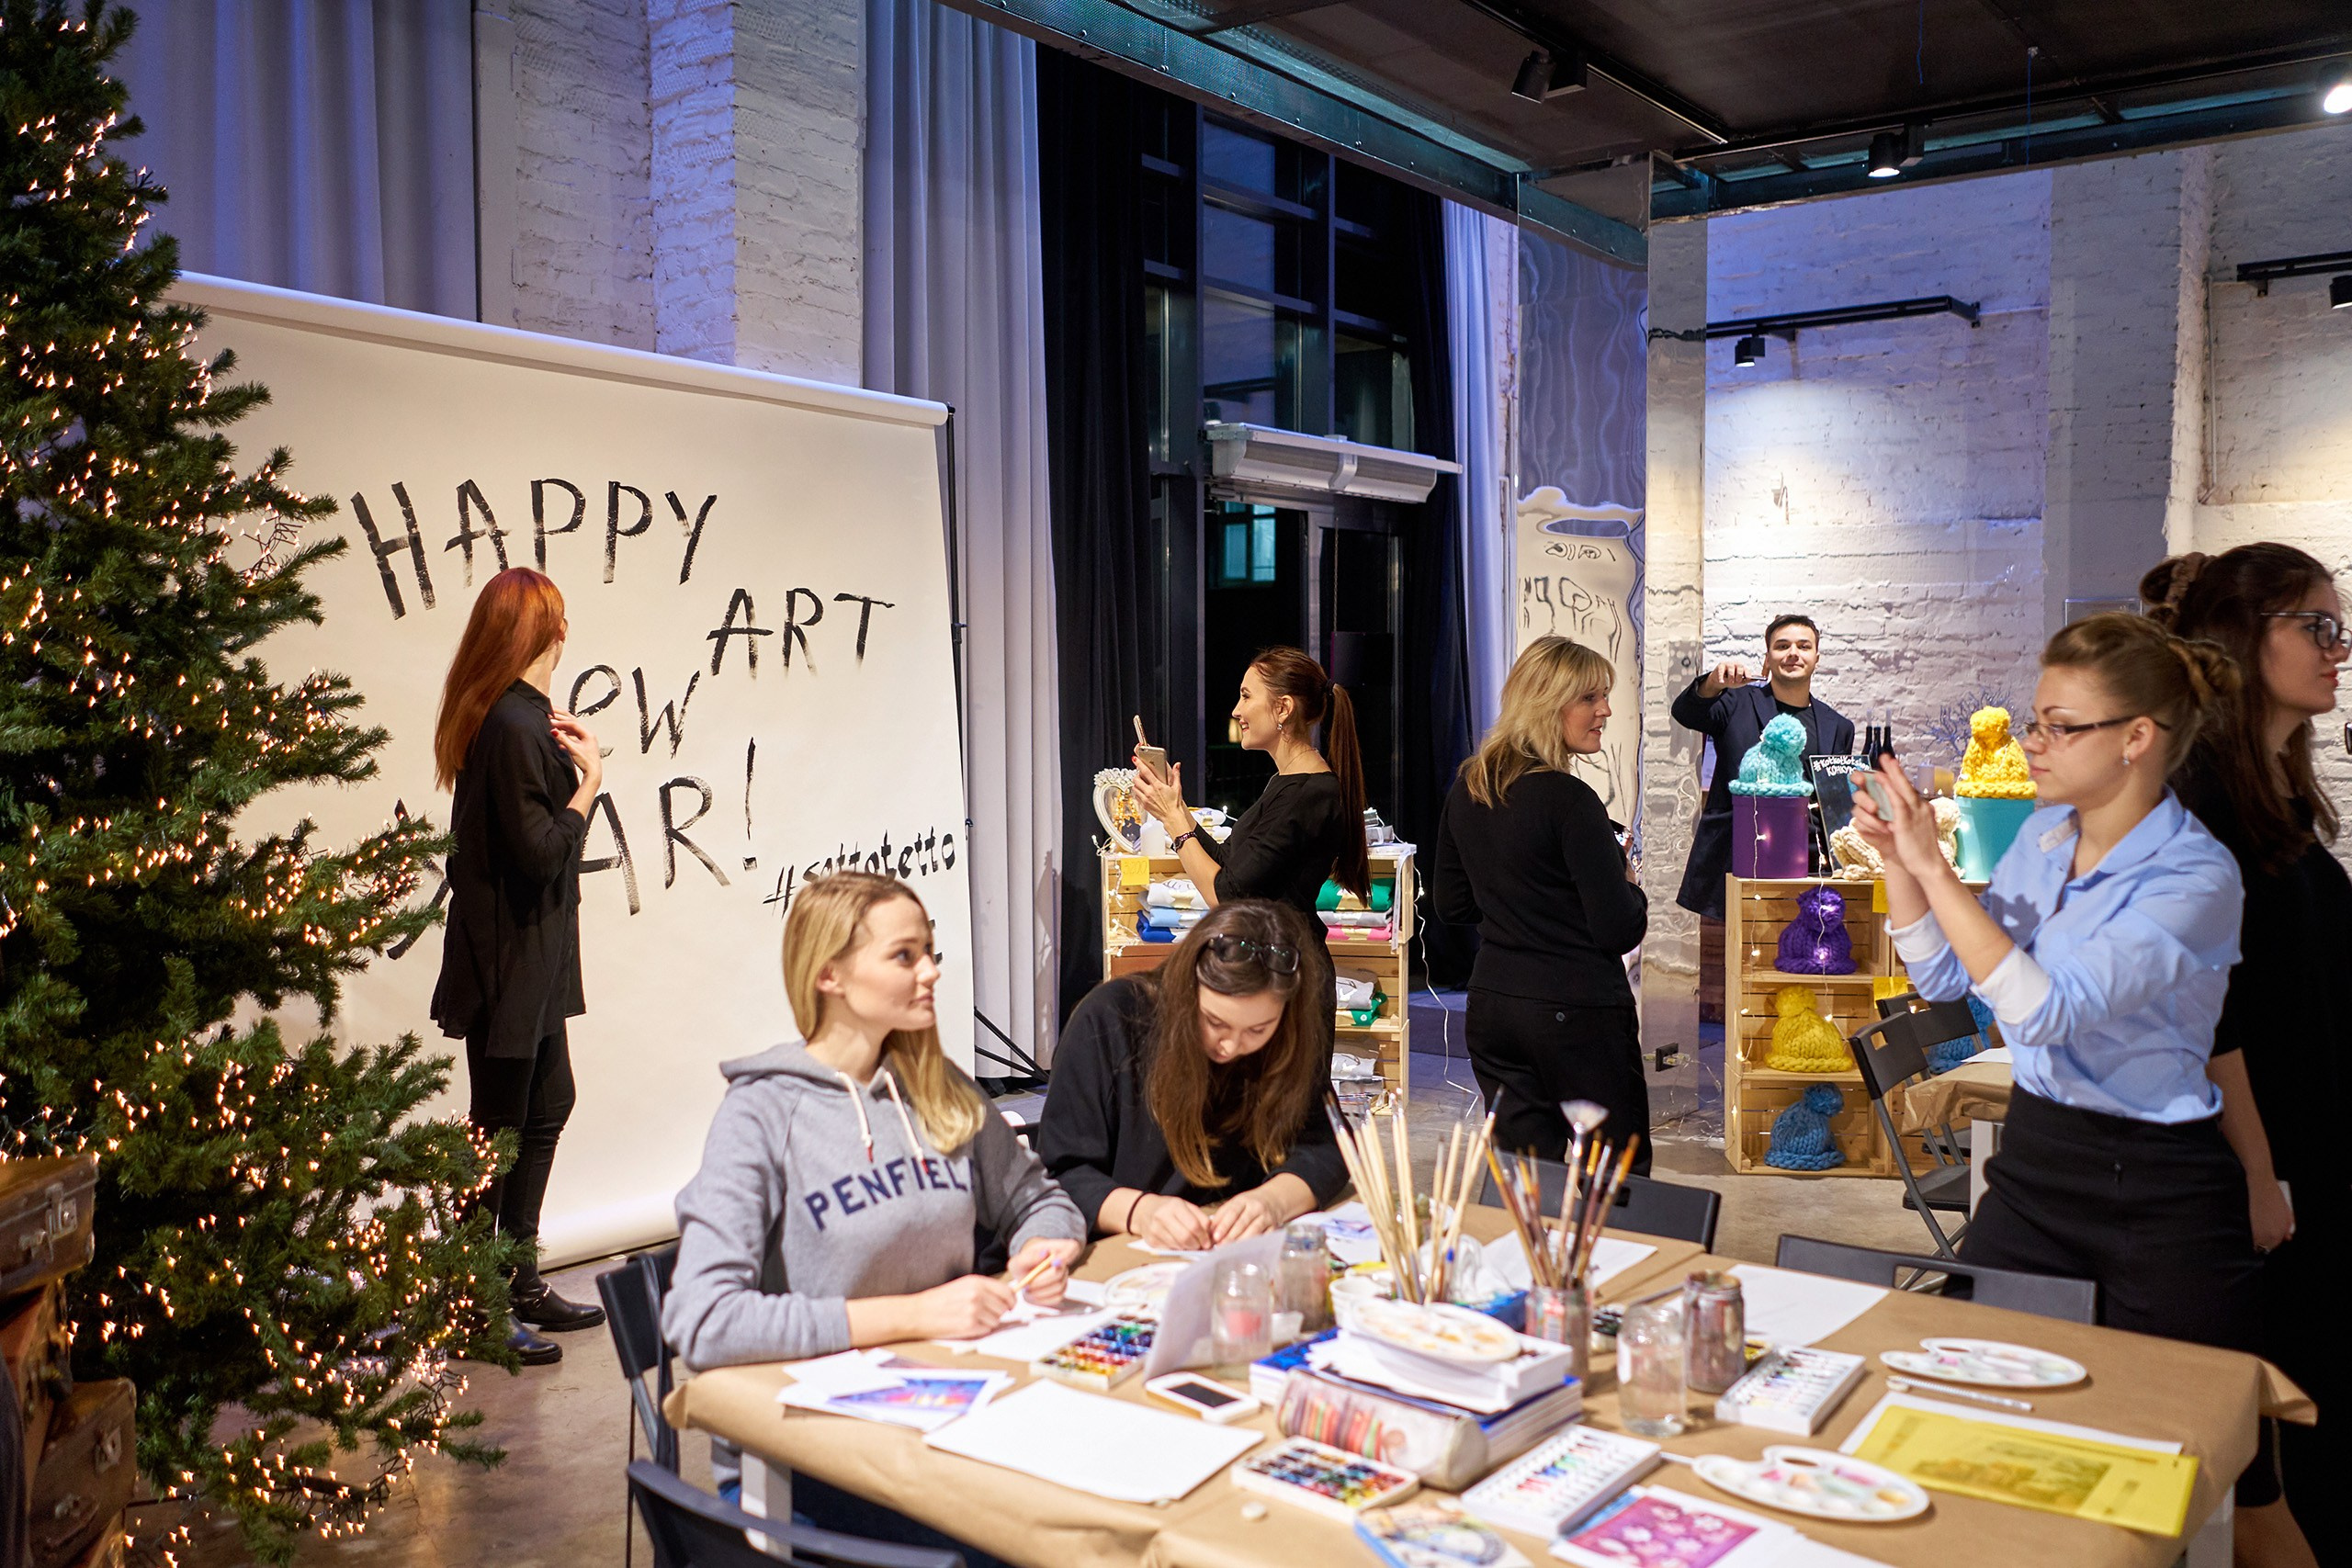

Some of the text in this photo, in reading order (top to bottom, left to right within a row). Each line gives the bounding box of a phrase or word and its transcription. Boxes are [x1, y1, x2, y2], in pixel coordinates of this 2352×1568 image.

[350, 479, 718, 620] HAPPY
[707, 588, 896, 680] ART
[569, 664, 701, 759] eW
